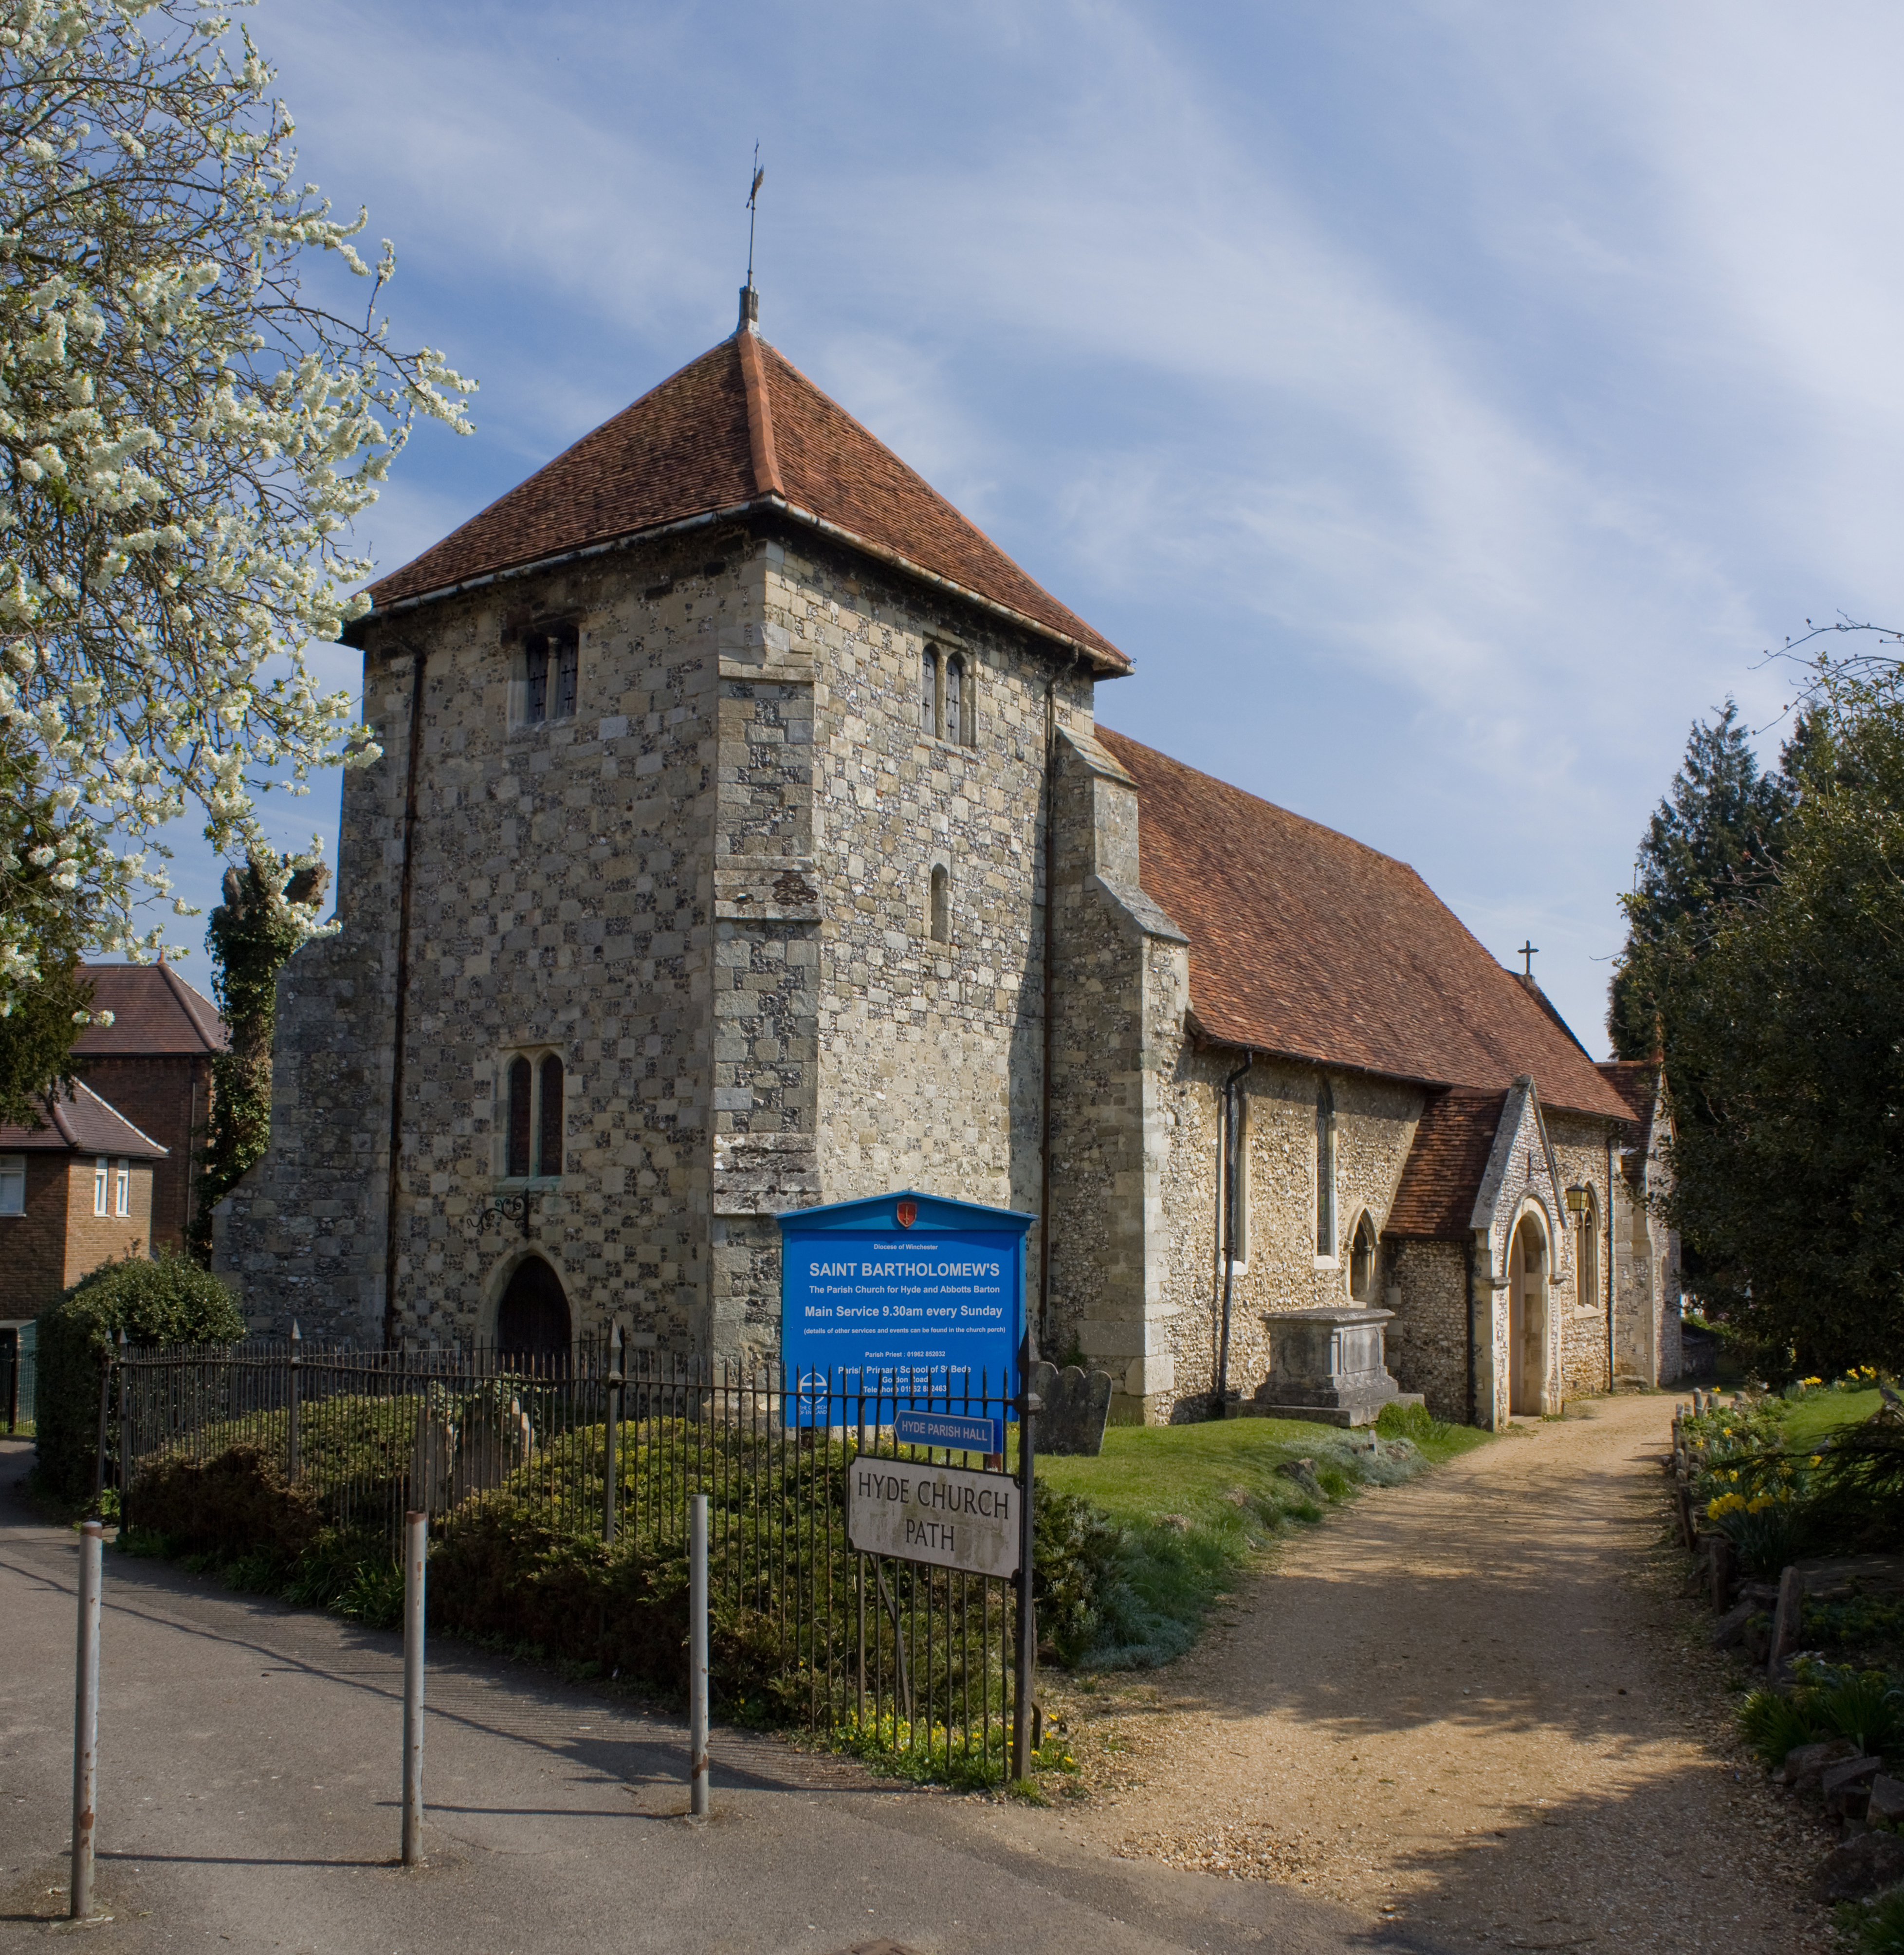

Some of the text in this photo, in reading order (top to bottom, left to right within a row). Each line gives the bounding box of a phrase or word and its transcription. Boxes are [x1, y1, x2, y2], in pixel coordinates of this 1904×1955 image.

[809, 1263, 1000, 1276] SAINT BARTHOLOMEW'S
[826, 1285, 853, 1293] Parish
[855, 1285, 885, 1293] Church
[887, 1285, 899, 1293] for
[900, 1285, 921, 1295] Hyde
[923, 1285, 938, 1293] and
[805, 1305, 1003, 1318] Main Service 9.30am every Sunday
[951, 1365, 971, 1373] Bede
[902, 1420, 988, 1441] HYDE PARISH HALL
[859, 1472, 1008, 1519] HYDE CHURCH
[906, 1518, 954, 1551] PATH
